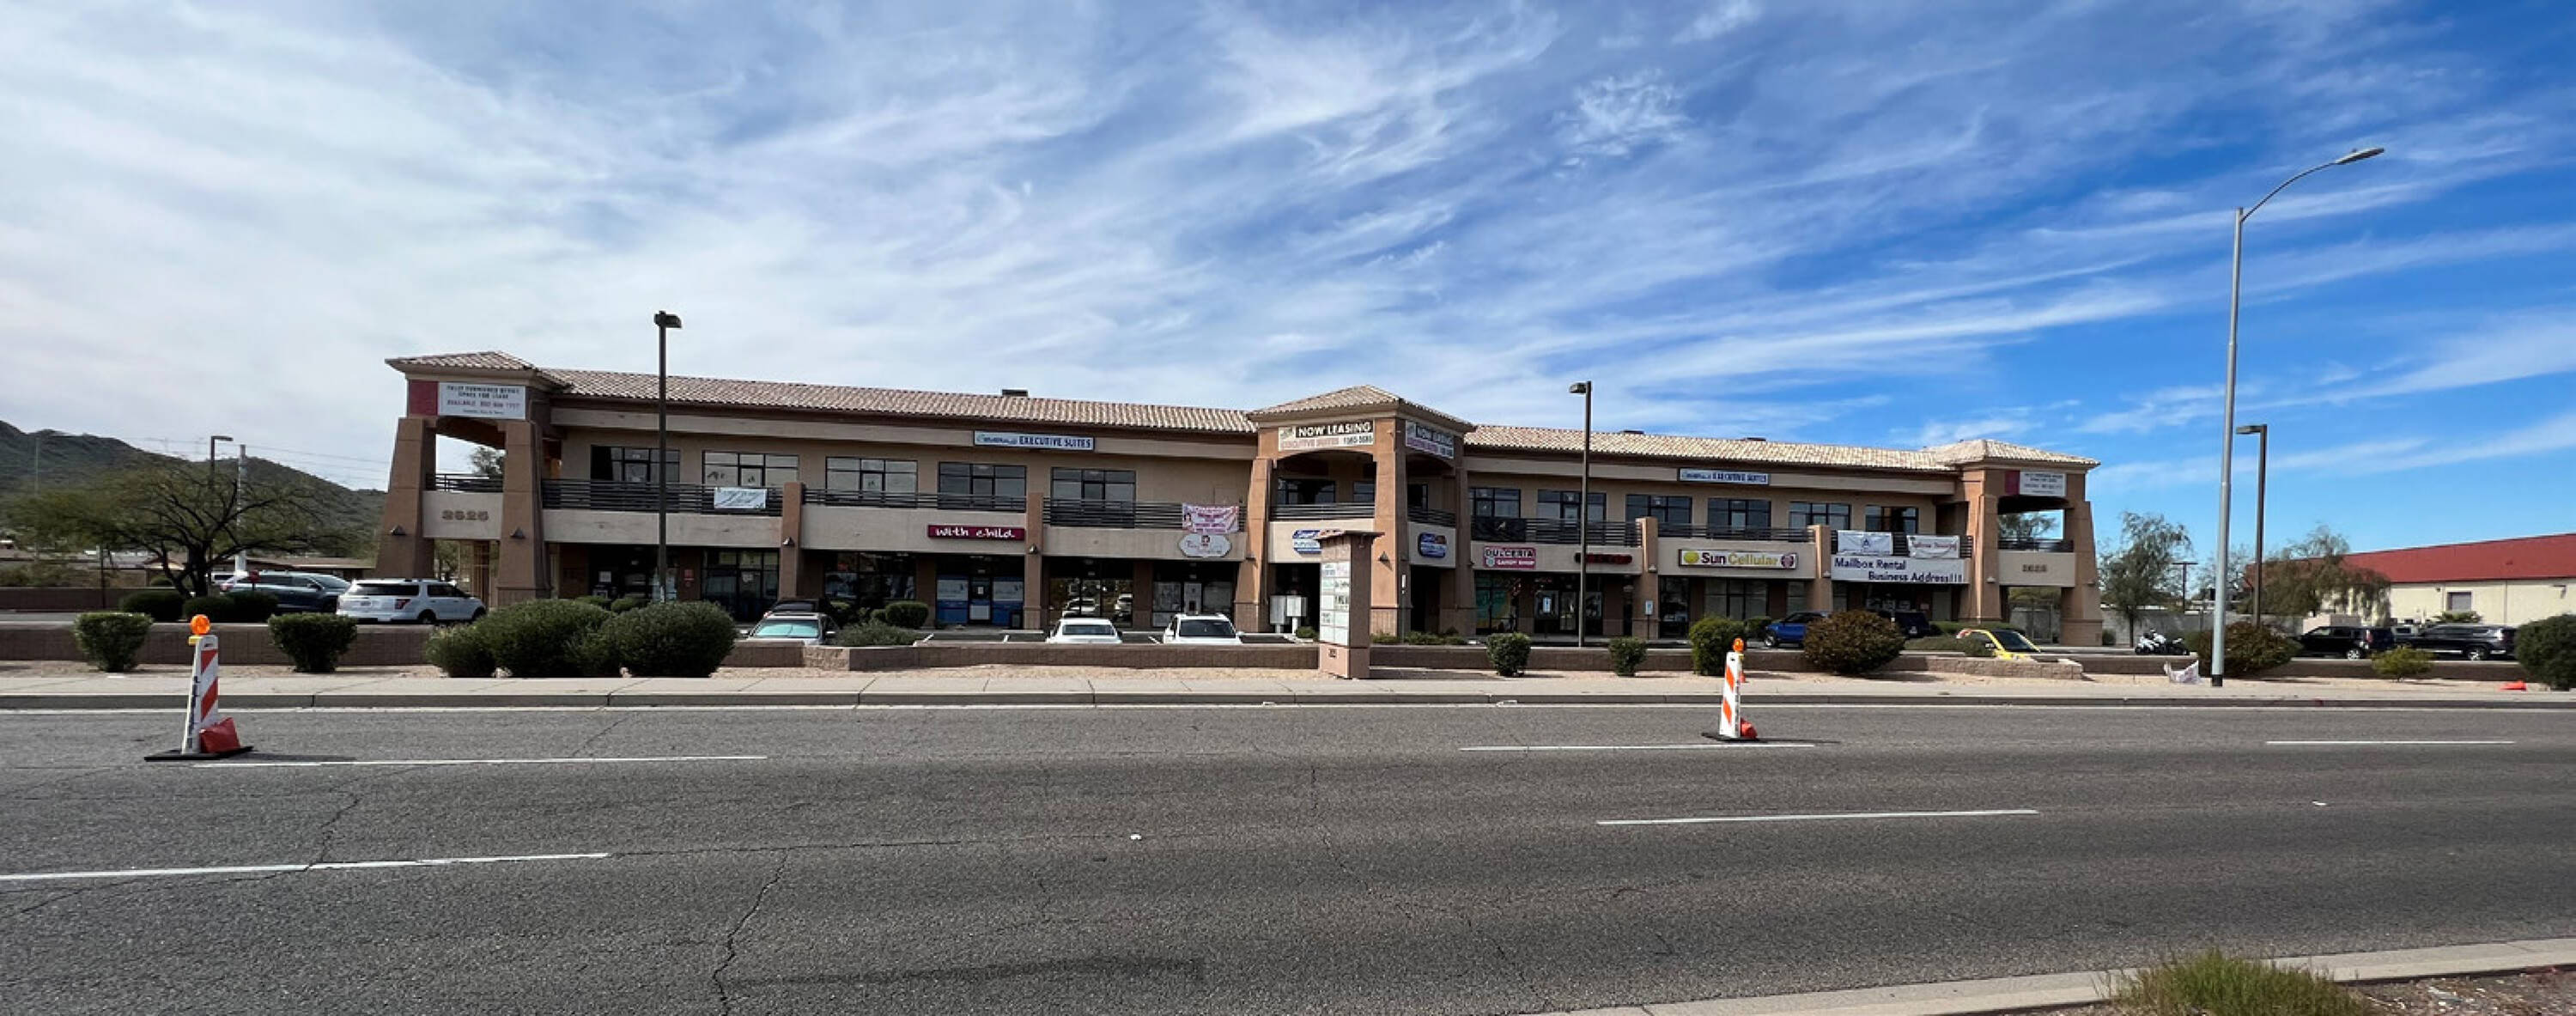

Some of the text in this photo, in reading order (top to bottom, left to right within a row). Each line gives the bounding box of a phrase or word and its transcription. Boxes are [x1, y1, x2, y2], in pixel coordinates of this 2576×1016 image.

[1298, 422, 1371, 437] NOW LEASING
[1018, 435, 1062, 447] EXECUTIVE
[1065, 438, 1091, 448] SUITES
[935, 526, 969, 537] with
[1484, 549, 1534, 557] DULCERIA
[1701, 552, 1778, 565] Sun Cellular
[1834, 557, 1907, 570] Mailbox Rental
[1868, 571, 1908, 581] Business
